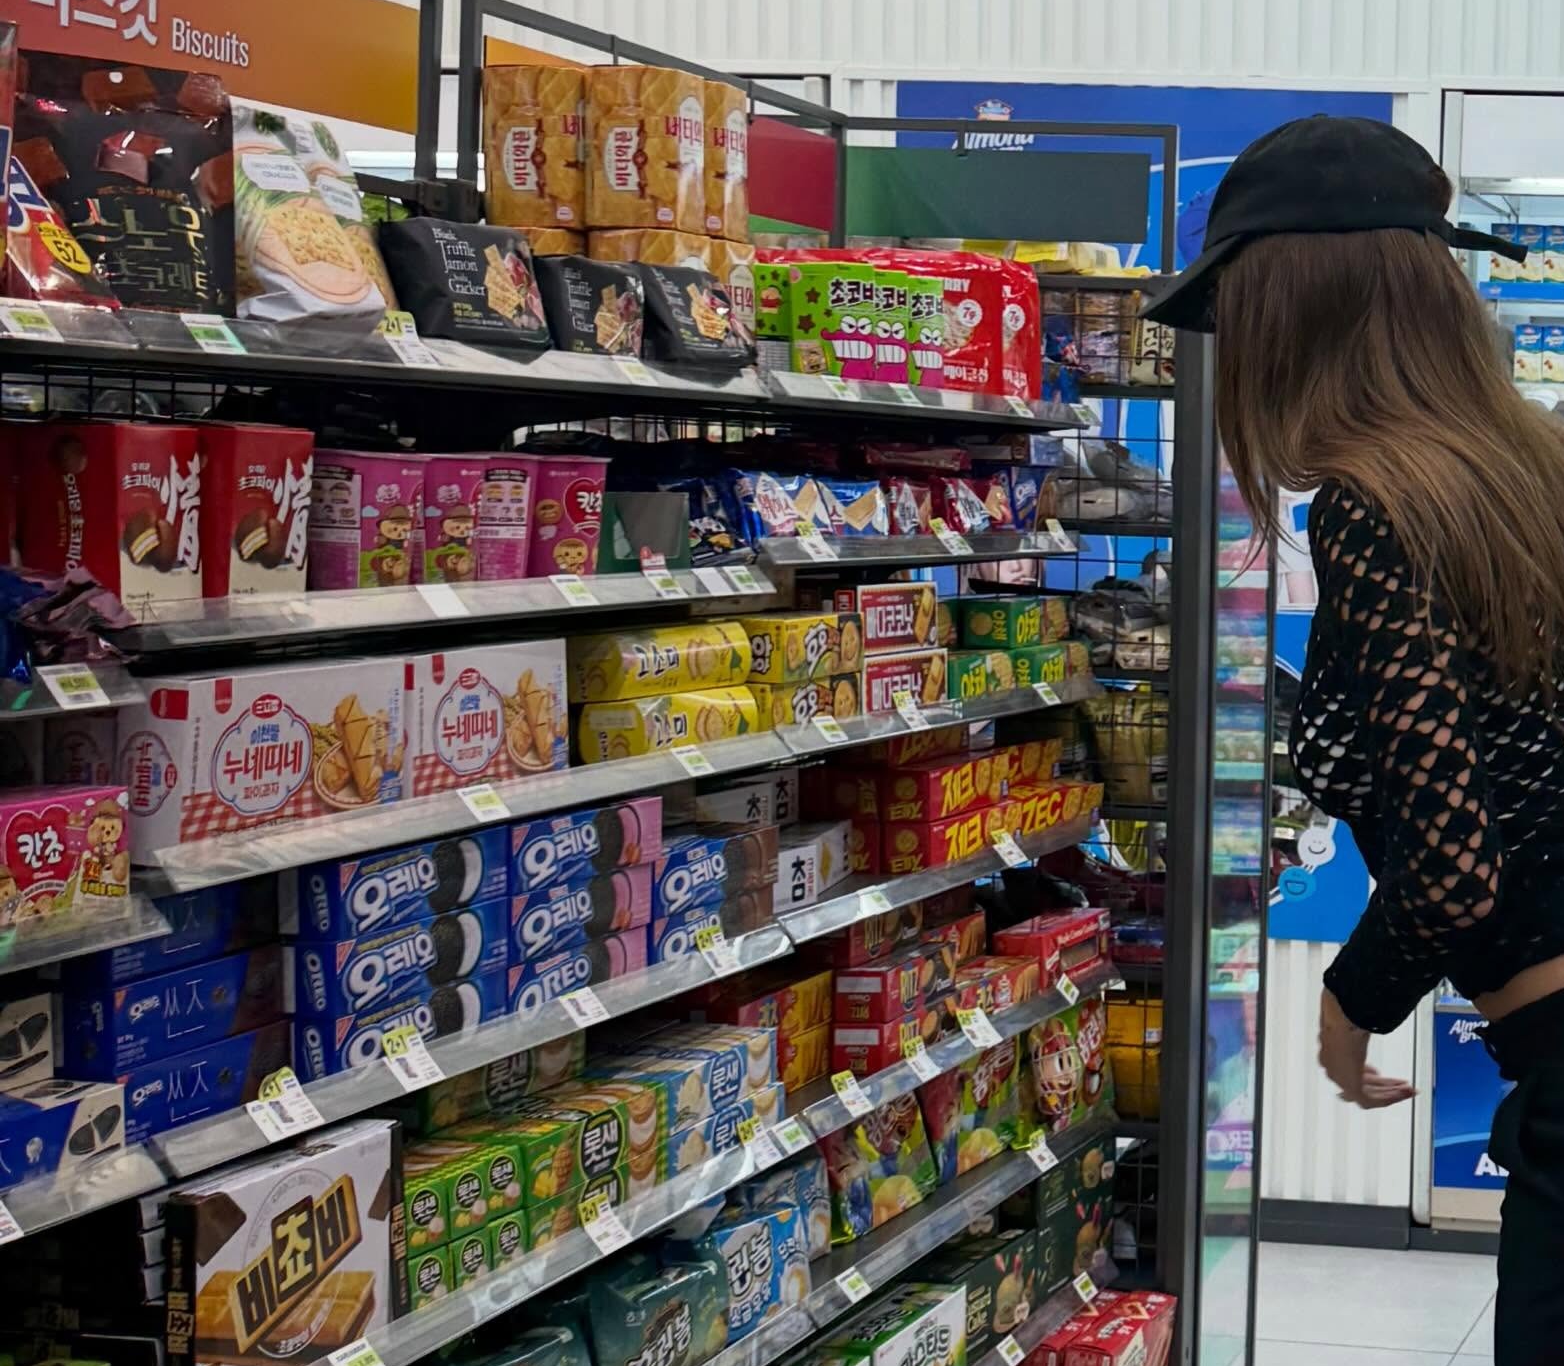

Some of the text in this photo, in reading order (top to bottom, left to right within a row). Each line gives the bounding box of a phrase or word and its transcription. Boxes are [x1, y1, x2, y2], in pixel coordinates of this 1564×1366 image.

[171, 17, 250, 68] Biscuits
[52, 239, 82, 264] 52
[435, 239, 477, 258] Truffle
[444, 258, 479, 274] Jamon
[865, 602, 915, 640] 빠다코코낫
[632, 642, 680, 679] 고소미
[440, 708, 499, 743] 누네띠네
[222, 739, 304, 786] 누네띠네
[944, 814, 987, 863] 제크
[1021, 792, 1063, 837] ZEC
[16, 825, 65, 869] 칸쵸
[521, 822, 598, 889] 오레오
[348, 856, 439, 932] 오레오
[663, 852, 727, 915] 오레오
[518, 889, 593, 958] 오레오
[346, 930, 438, 1011] 오레오
[516, 954, 591, 1021] OREO
[386, 1036, 407, 1055] 2+1
[711, 1062, 742, 1102] 롯샌
[582, 1117, 620, 1168] 롯샌
[236, 1184, 353, 1338] 비쵸비
[728, 1221, 772, 1297] 런볼
